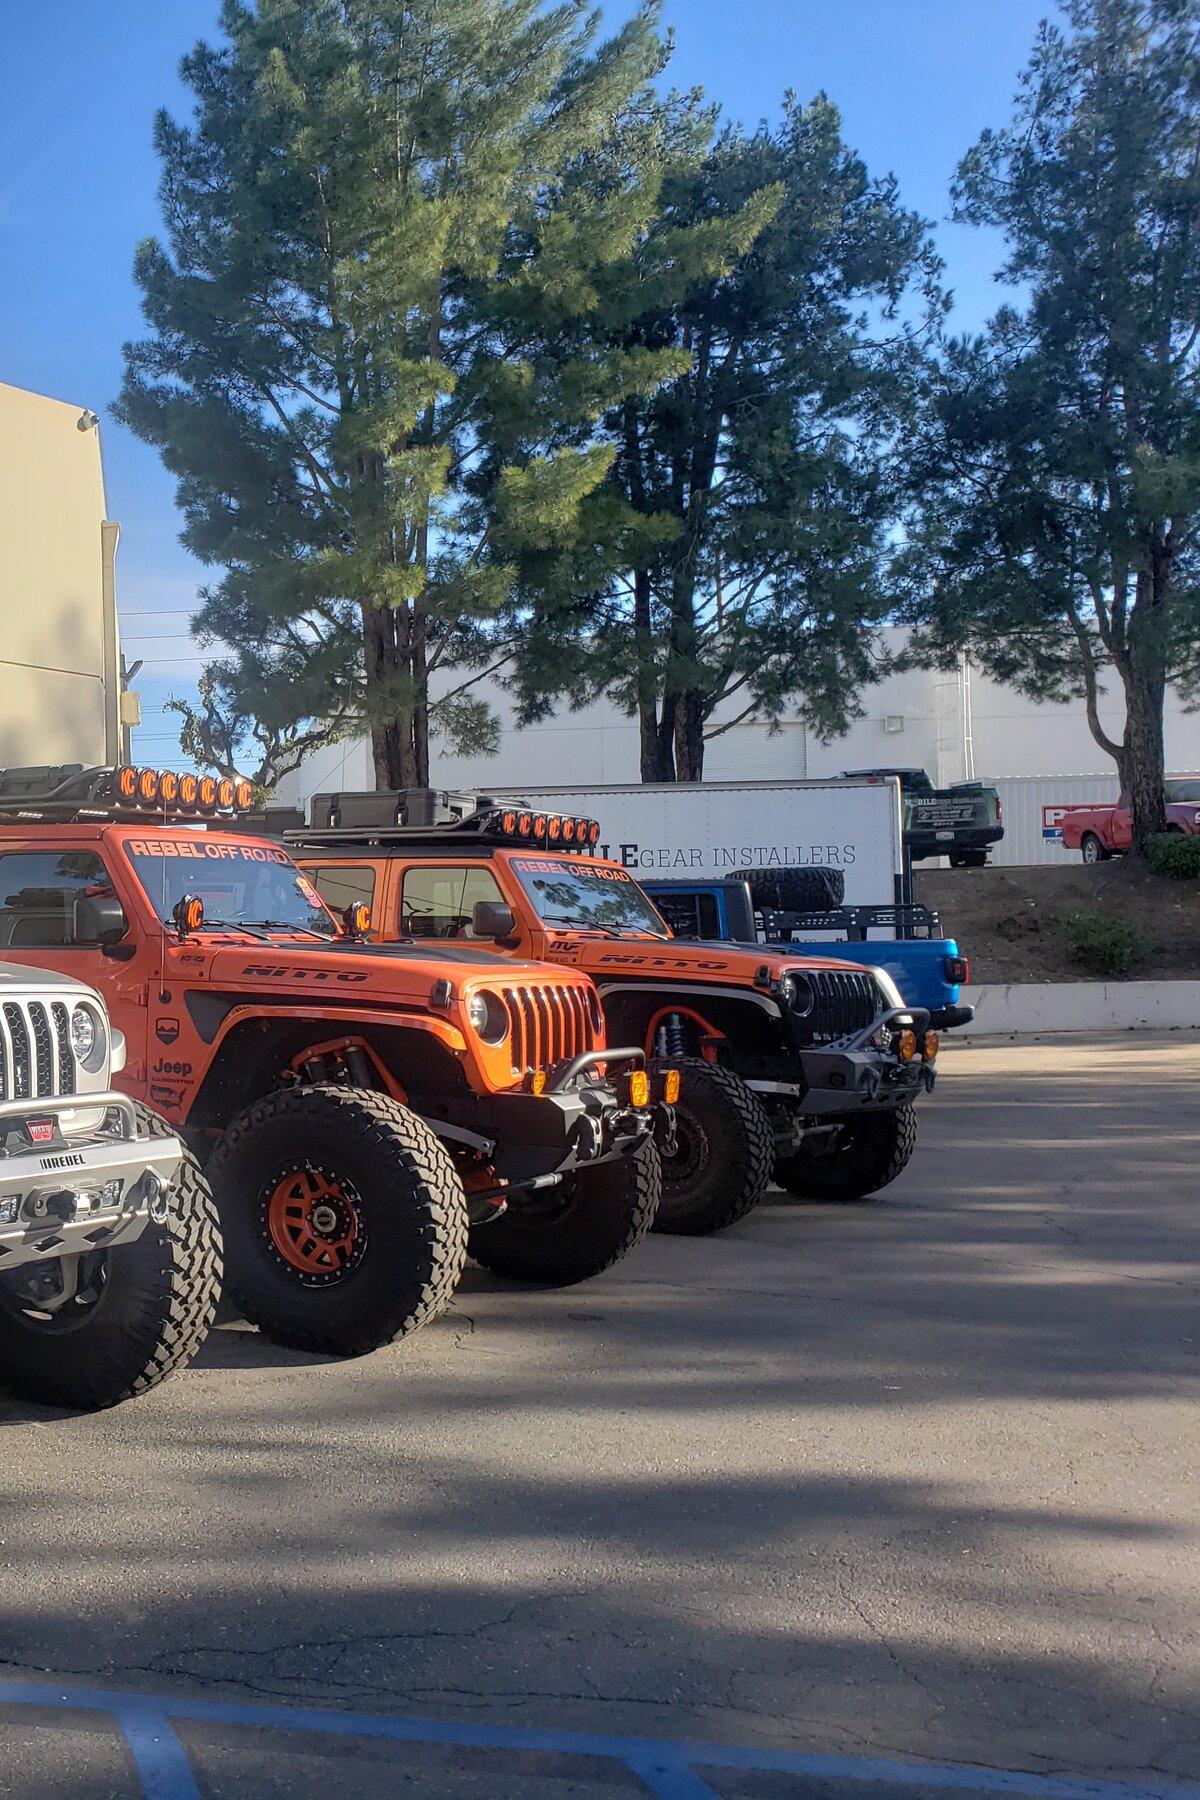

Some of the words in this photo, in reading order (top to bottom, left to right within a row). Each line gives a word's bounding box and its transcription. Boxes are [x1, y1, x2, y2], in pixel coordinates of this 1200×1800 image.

[120, 768, 135, 795] KC
[141, 771, 156, 798] KC
[162, 774, 176, 801] KC
[182, 776, 196, 803] KC
[201, 778, 215, 805] KC
[220, 780, 233, 807] KC
[239, 781, 251, 808] KC
[129, 841, 206, 859] REBEL
[204, 844, 239, 860] OFF
[240, 847, 288, 865] ROAD
[712, 845, 857, 867] INSTALLERS
[514, 860, 569, 875] REBEL
[568, 865, 596, 878] OFF
[595, 867, 630, 883] ROAD
[188, 900, 203, 928] KC
[357, 905, 369, 931] KC
[241, 964, 369, 982] NITTO
[599, 954, 728, 970] NITTO
[153, 1058, 192, 1077] Jeep
